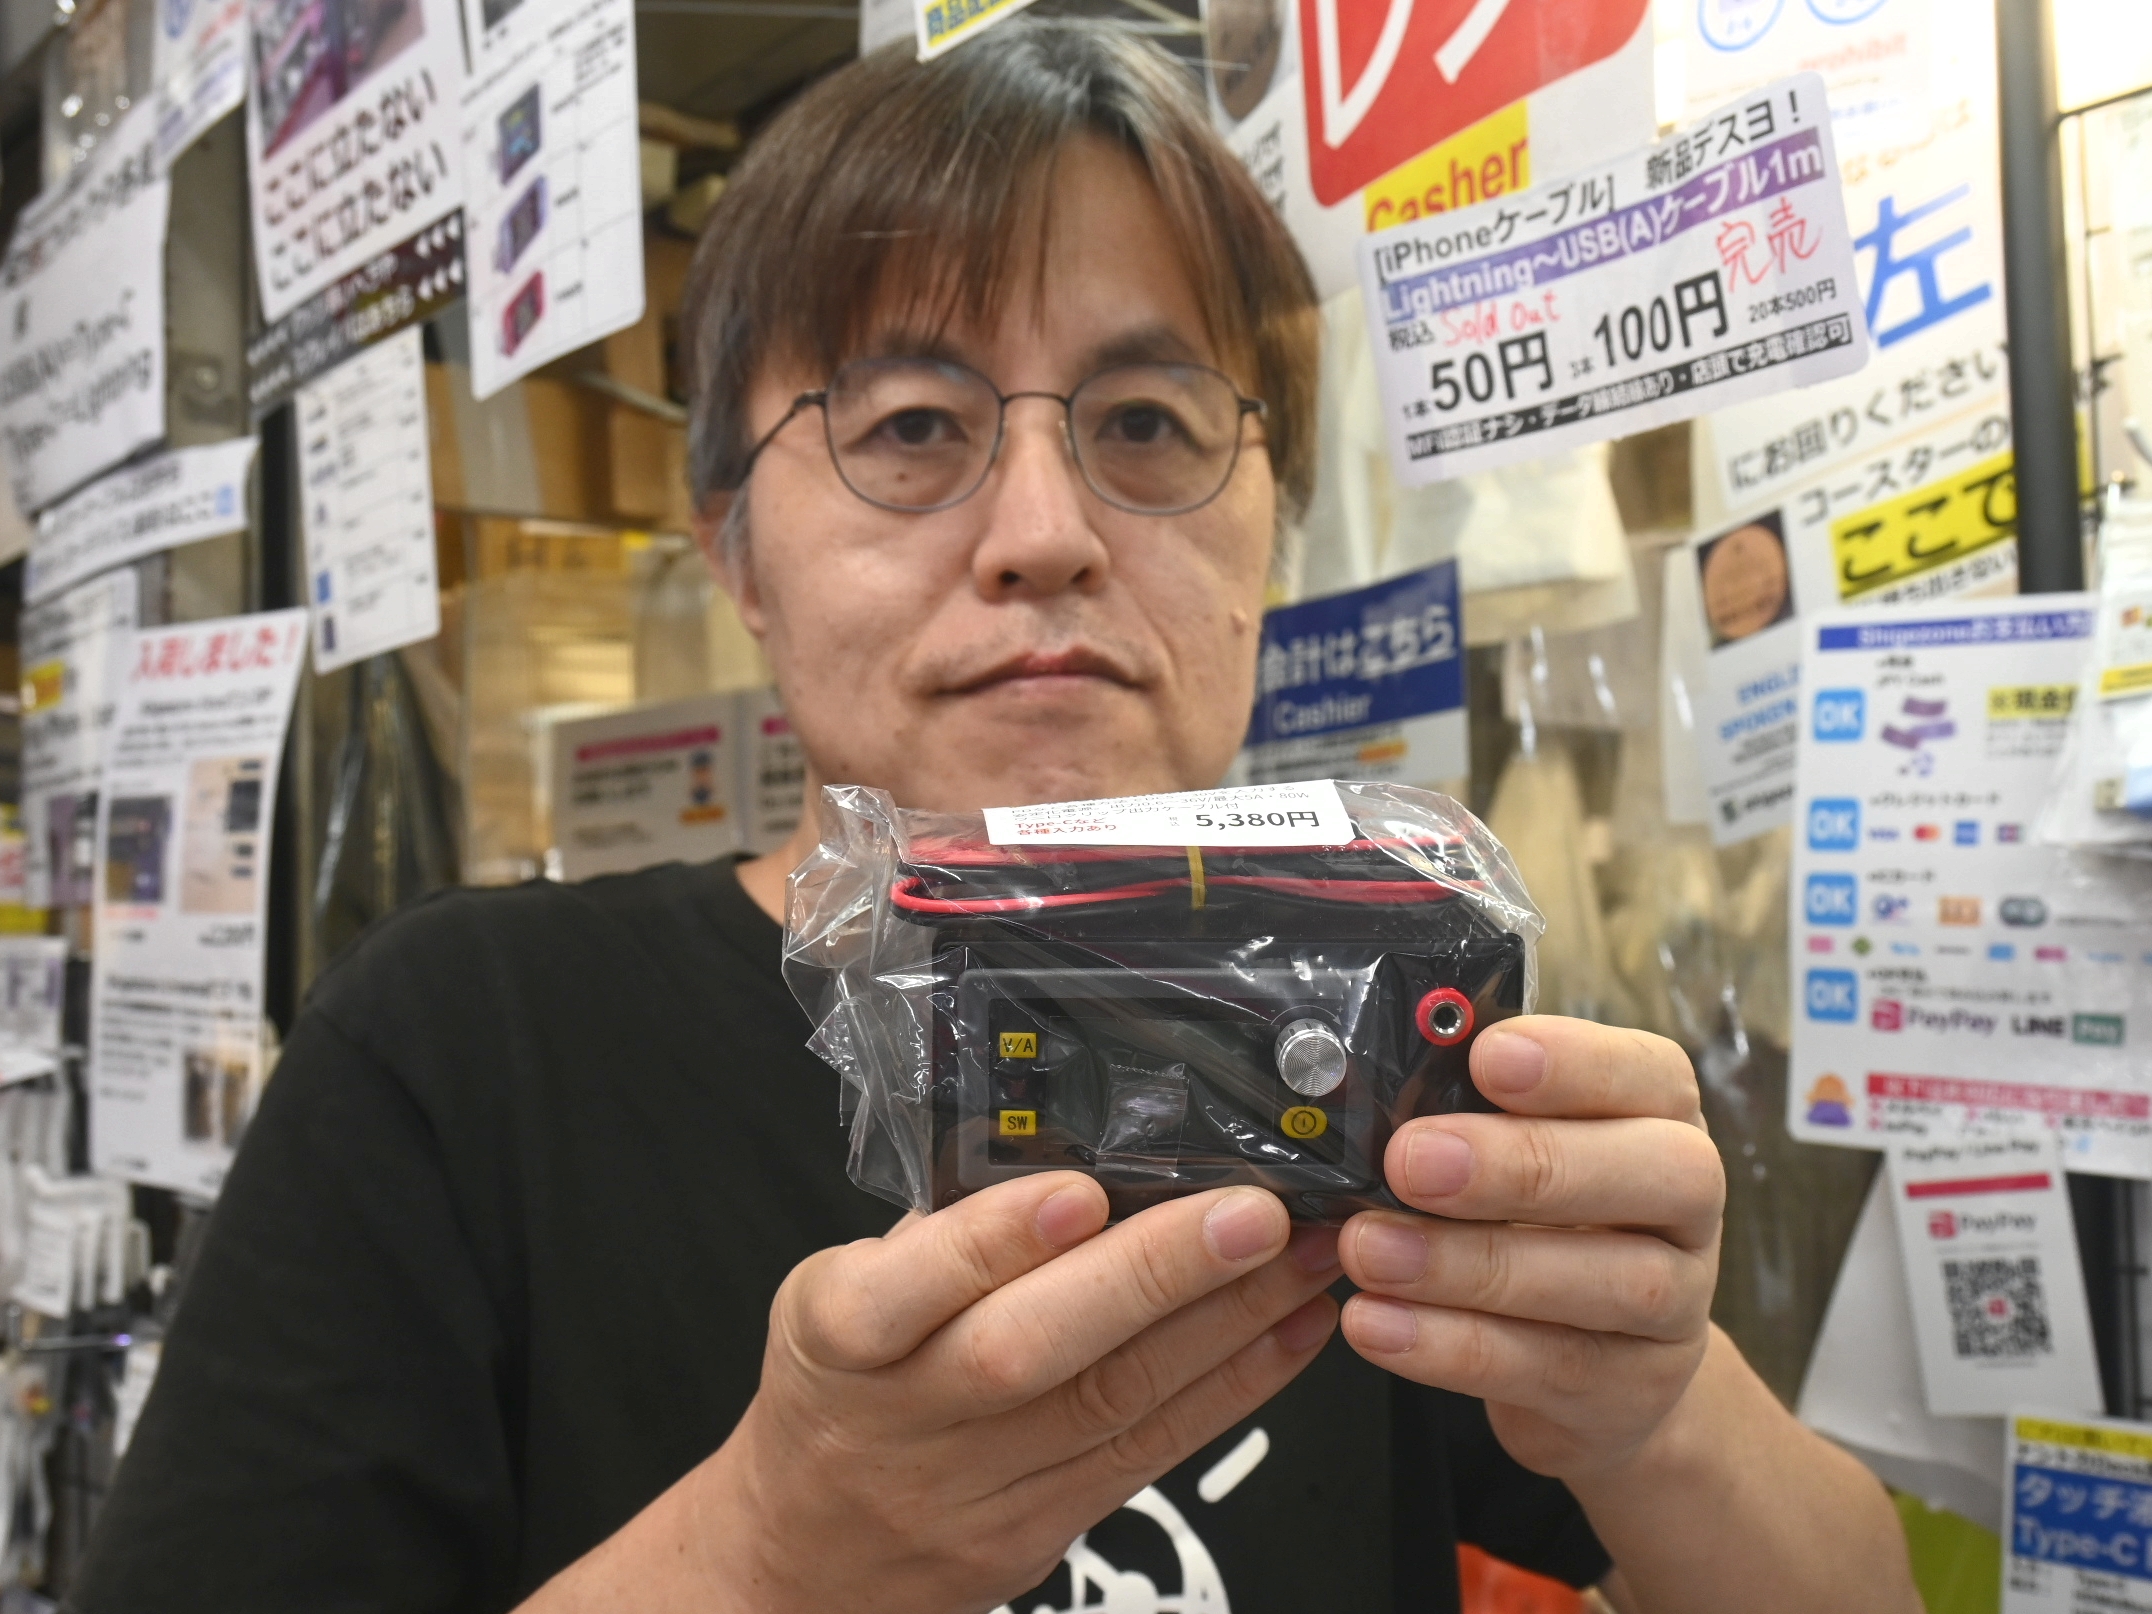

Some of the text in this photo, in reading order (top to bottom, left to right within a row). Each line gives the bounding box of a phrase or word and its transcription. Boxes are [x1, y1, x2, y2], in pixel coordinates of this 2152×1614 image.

[1715, 197, 1823, 293] 完売
[1853, 183, 1992, 350] 左
[1439, 299, 1500, 347] Sold
[1388, 326, 1434, 352] 税込
[1431, 330, 1554, 412] 50円
[1594, 270, 1729, 367] 100円
[1748, 277, 1837, 324] 20本500円
[1273, 693, 1372, 734] Cashier
[1816, 703, 1861, 729] OK
[1017, 824, 1117, 836] 各種入力あり
[1195, 810, 1320, 831] 5,380円
[1811, 810, 1857, 837] OK
[1809, 885, 1854, 915] OK
[1809, 979, 1855, 1010] OK
[1905, 1003, 1998, 1037] PayPay
[2010, 1014, 2066, 1038] LINE
[1002, 1037, 1035, 1054] V/A
[1007, 1115, 1028, 1130] SW
